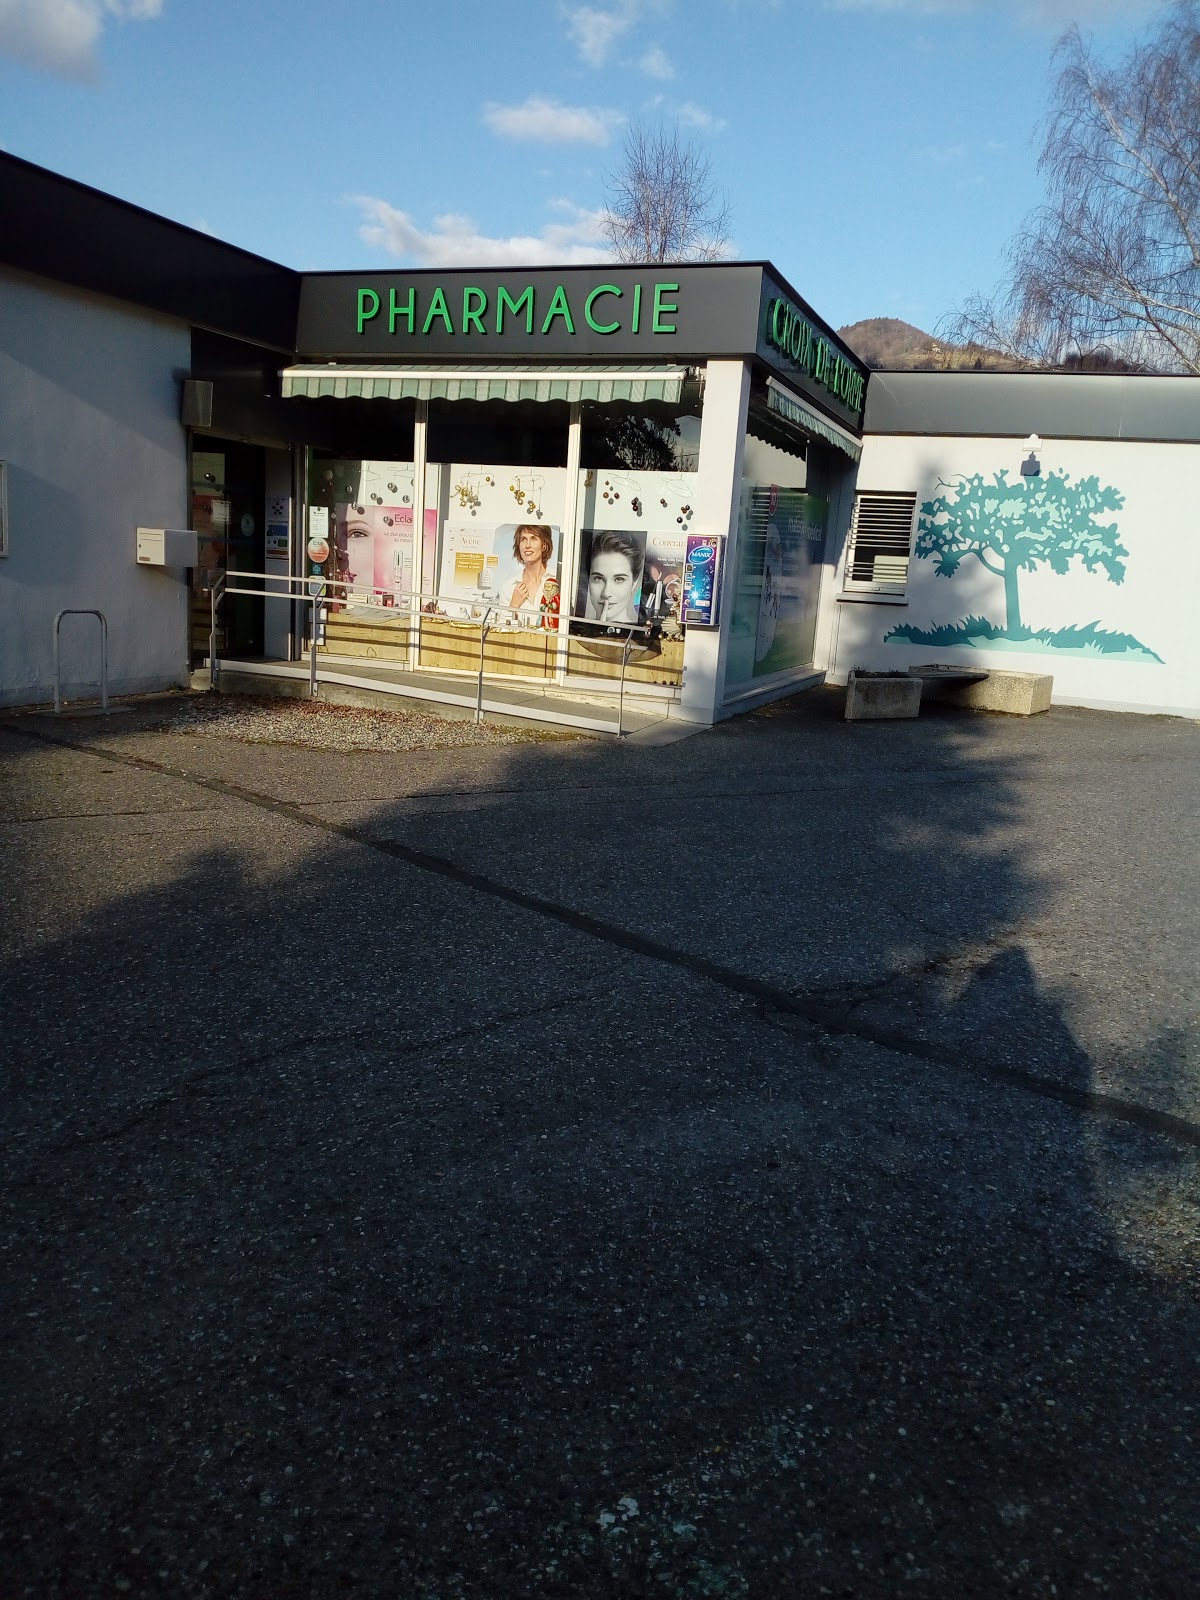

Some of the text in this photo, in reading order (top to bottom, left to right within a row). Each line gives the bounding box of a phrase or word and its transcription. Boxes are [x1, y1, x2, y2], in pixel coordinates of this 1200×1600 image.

[357, 283, 680, 335] PHARMACIE
[772, 297, 865, 413] CROIX DE L'ORME
